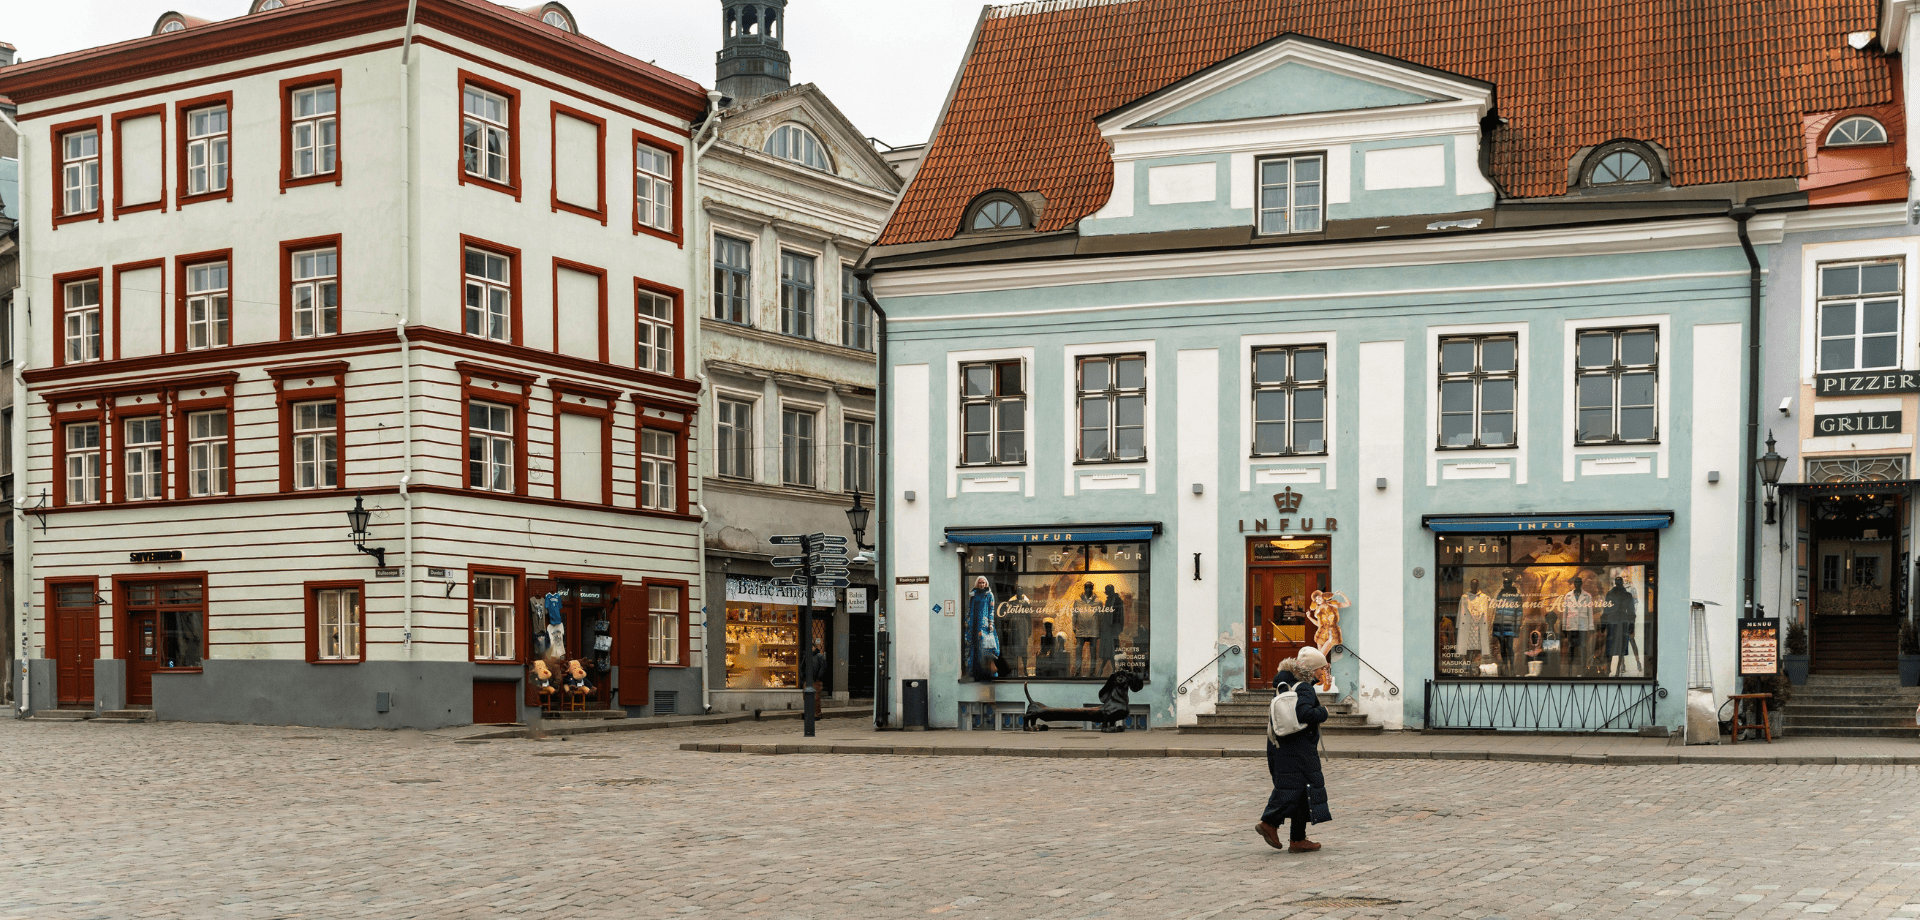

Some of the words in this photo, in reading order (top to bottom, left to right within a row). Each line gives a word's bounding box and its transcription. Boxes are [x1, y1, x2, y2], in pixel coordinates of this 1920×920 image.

[1823, 374, 1920, 392] PIZZER
[1820, 415, 1895, 432] GRILL
[1238, 517, 1338, 533] INFUR
[1518, 522, 1575, 530] INFUR
[1446, 545, 1499, 554] INFUR
[1591, 543, 1646, 551] INFUR
[970, 555, 1016, 563] INFUR
[996, 601, 1034, 618] Clothes
[1057, 602, 1116, 616] Accessories
[1480, 596, 1521, 610] lothes
[1522, 598, 1545, 609] and
[1546, 595, 1614, 613] Accessories
